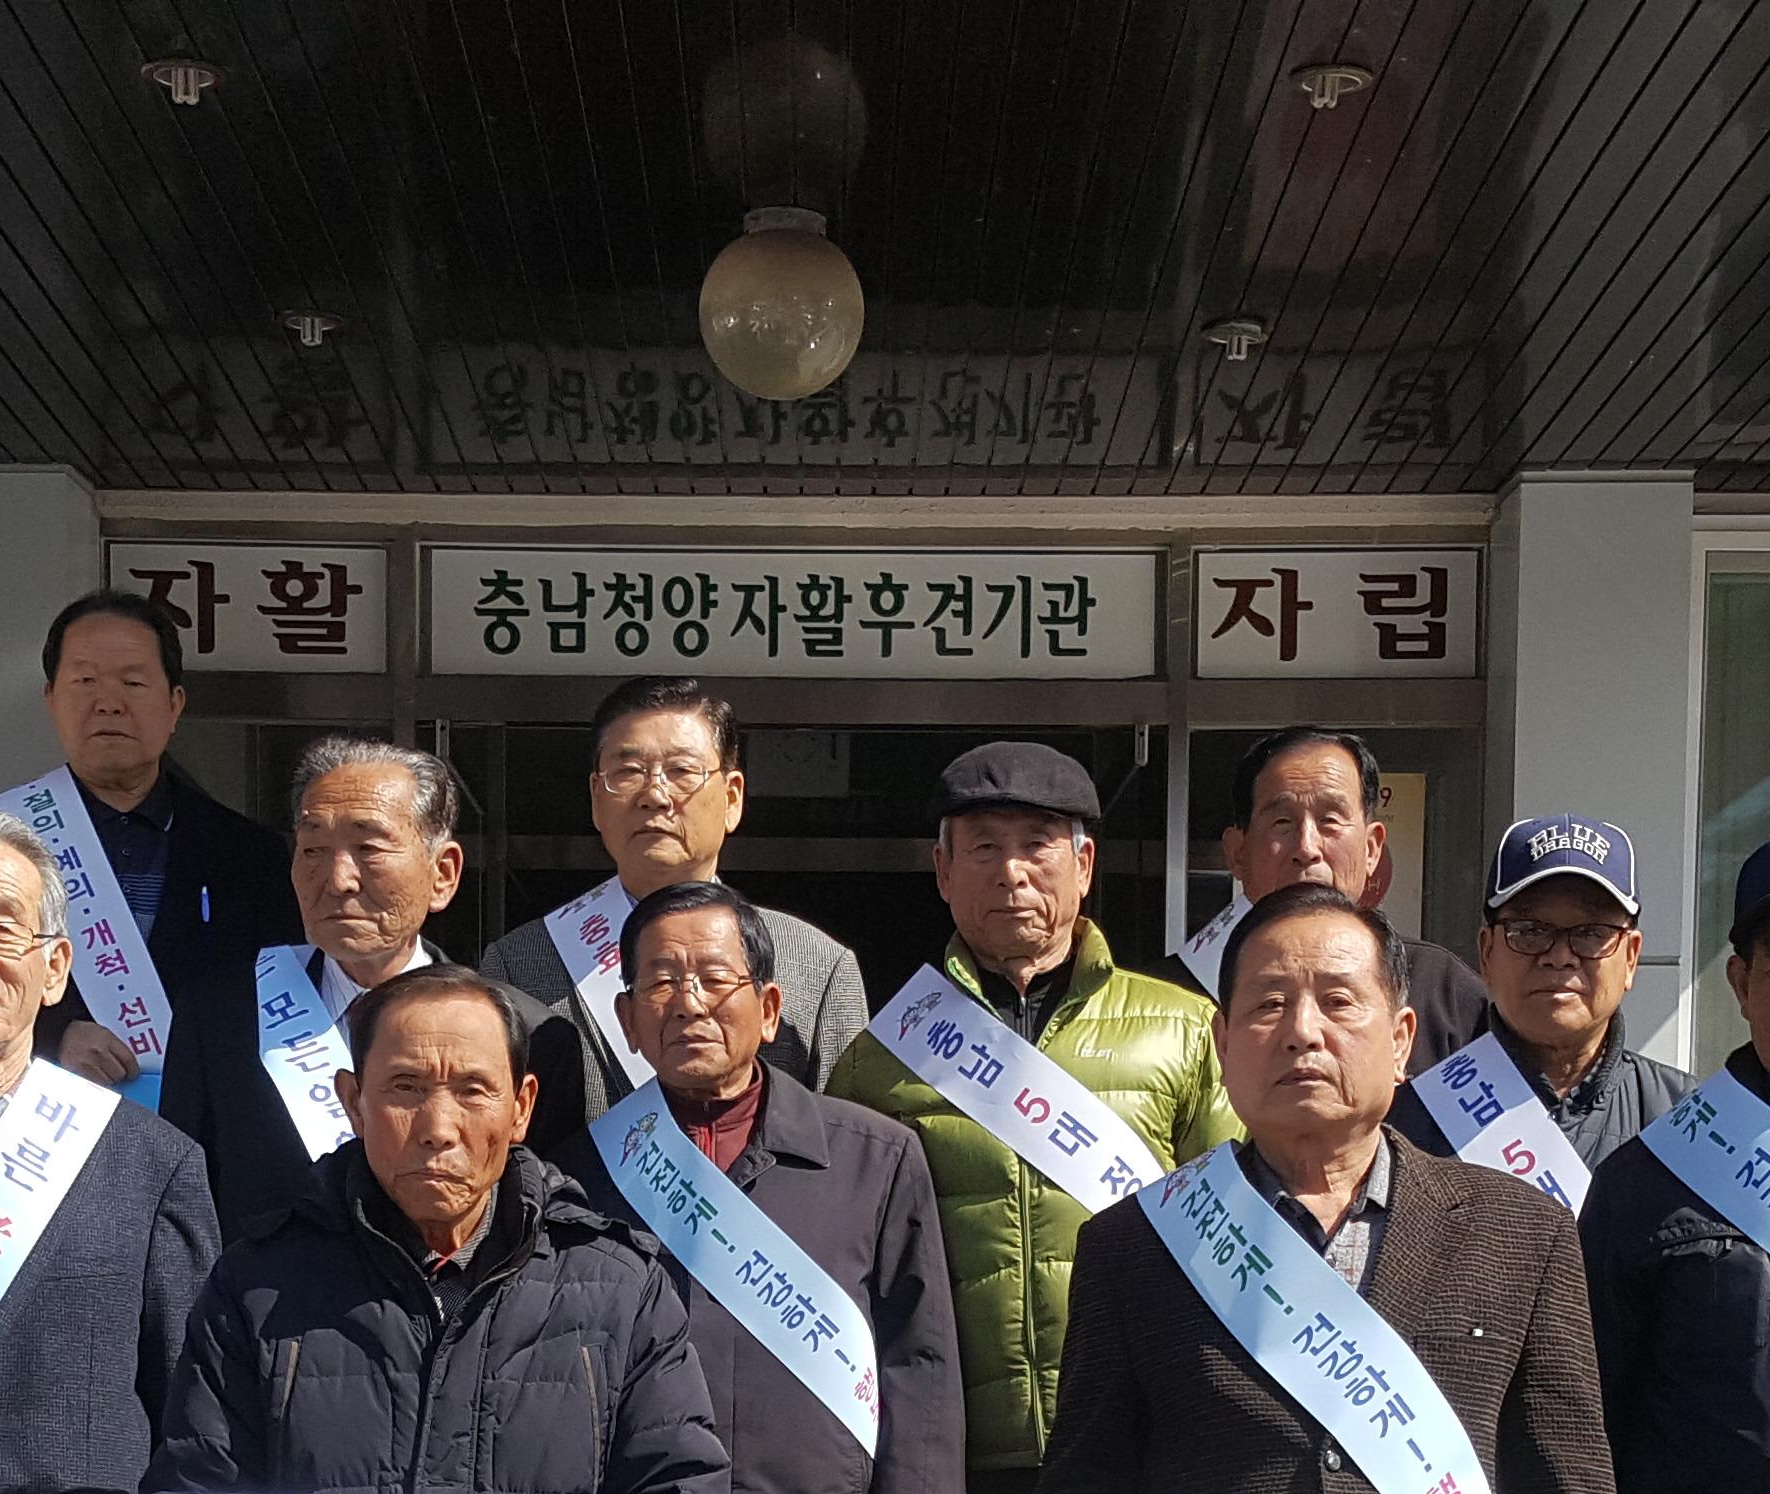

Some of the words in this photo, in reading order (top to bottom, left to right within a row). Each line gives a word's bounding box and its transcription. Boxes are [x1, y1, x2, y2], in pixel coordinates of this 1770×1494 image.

[473, 568, 1098, 660] 충남청양자활후견기관
[81, 918, 130, 977] 개척
[117, 996, 163, 1057] 선비
[0, 1092, 79, 1192] 바른
[927, 1019, 1005, 1089] 충남
[1013, 1087, 1099, 1157] 5대
[1439, 1053, 1506, 1128] 충남
[735, 1249, 857, 1373] 건강하게!
[1292, 1312, 1433, 1472] 건강하게!
